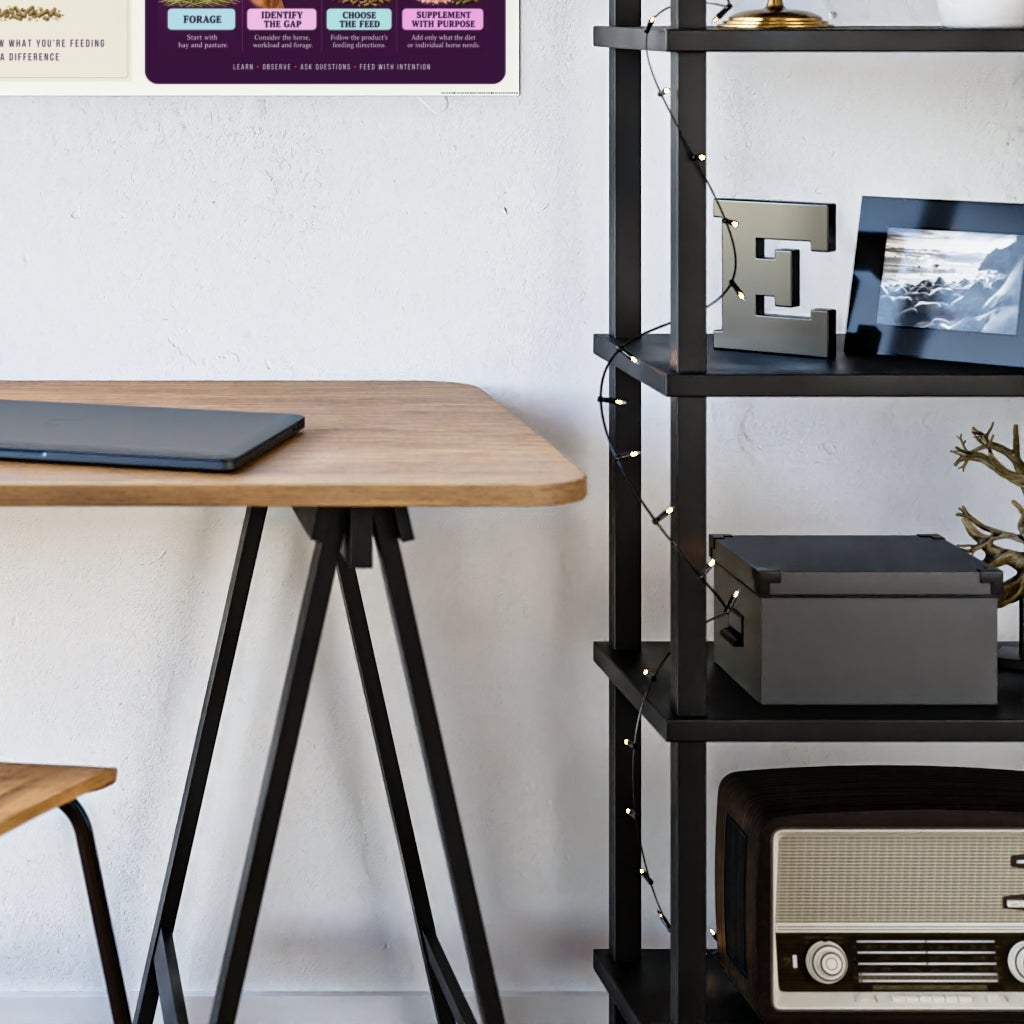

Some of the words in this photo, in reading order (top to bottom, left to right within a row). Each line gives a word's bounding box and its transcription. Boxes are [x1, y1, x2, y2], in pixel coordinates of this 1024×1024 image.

[184, 15, 222, 23] FORAGE
[262, 11, 303, 19] IDENTIFY
[416, 11, 471, 19] SUPPLEMENT
[264, 20, 281, 28] THE
[284, 20, 302, 28] GAP
[340, 20, 356, 28] THE
[360, 20, 380, 28] FEED
[437, 20, 475, 28] PURPOSE
[9, 39, 31, 47] WHAT
[36, 39, 65, 47] YOU'RE
[70, 39, 104, 47] FEEDING
[0, 53, 5, 61] A
[9, 53, 59, 61] DIFFERENCE
[714, 199, 836, 358] E
